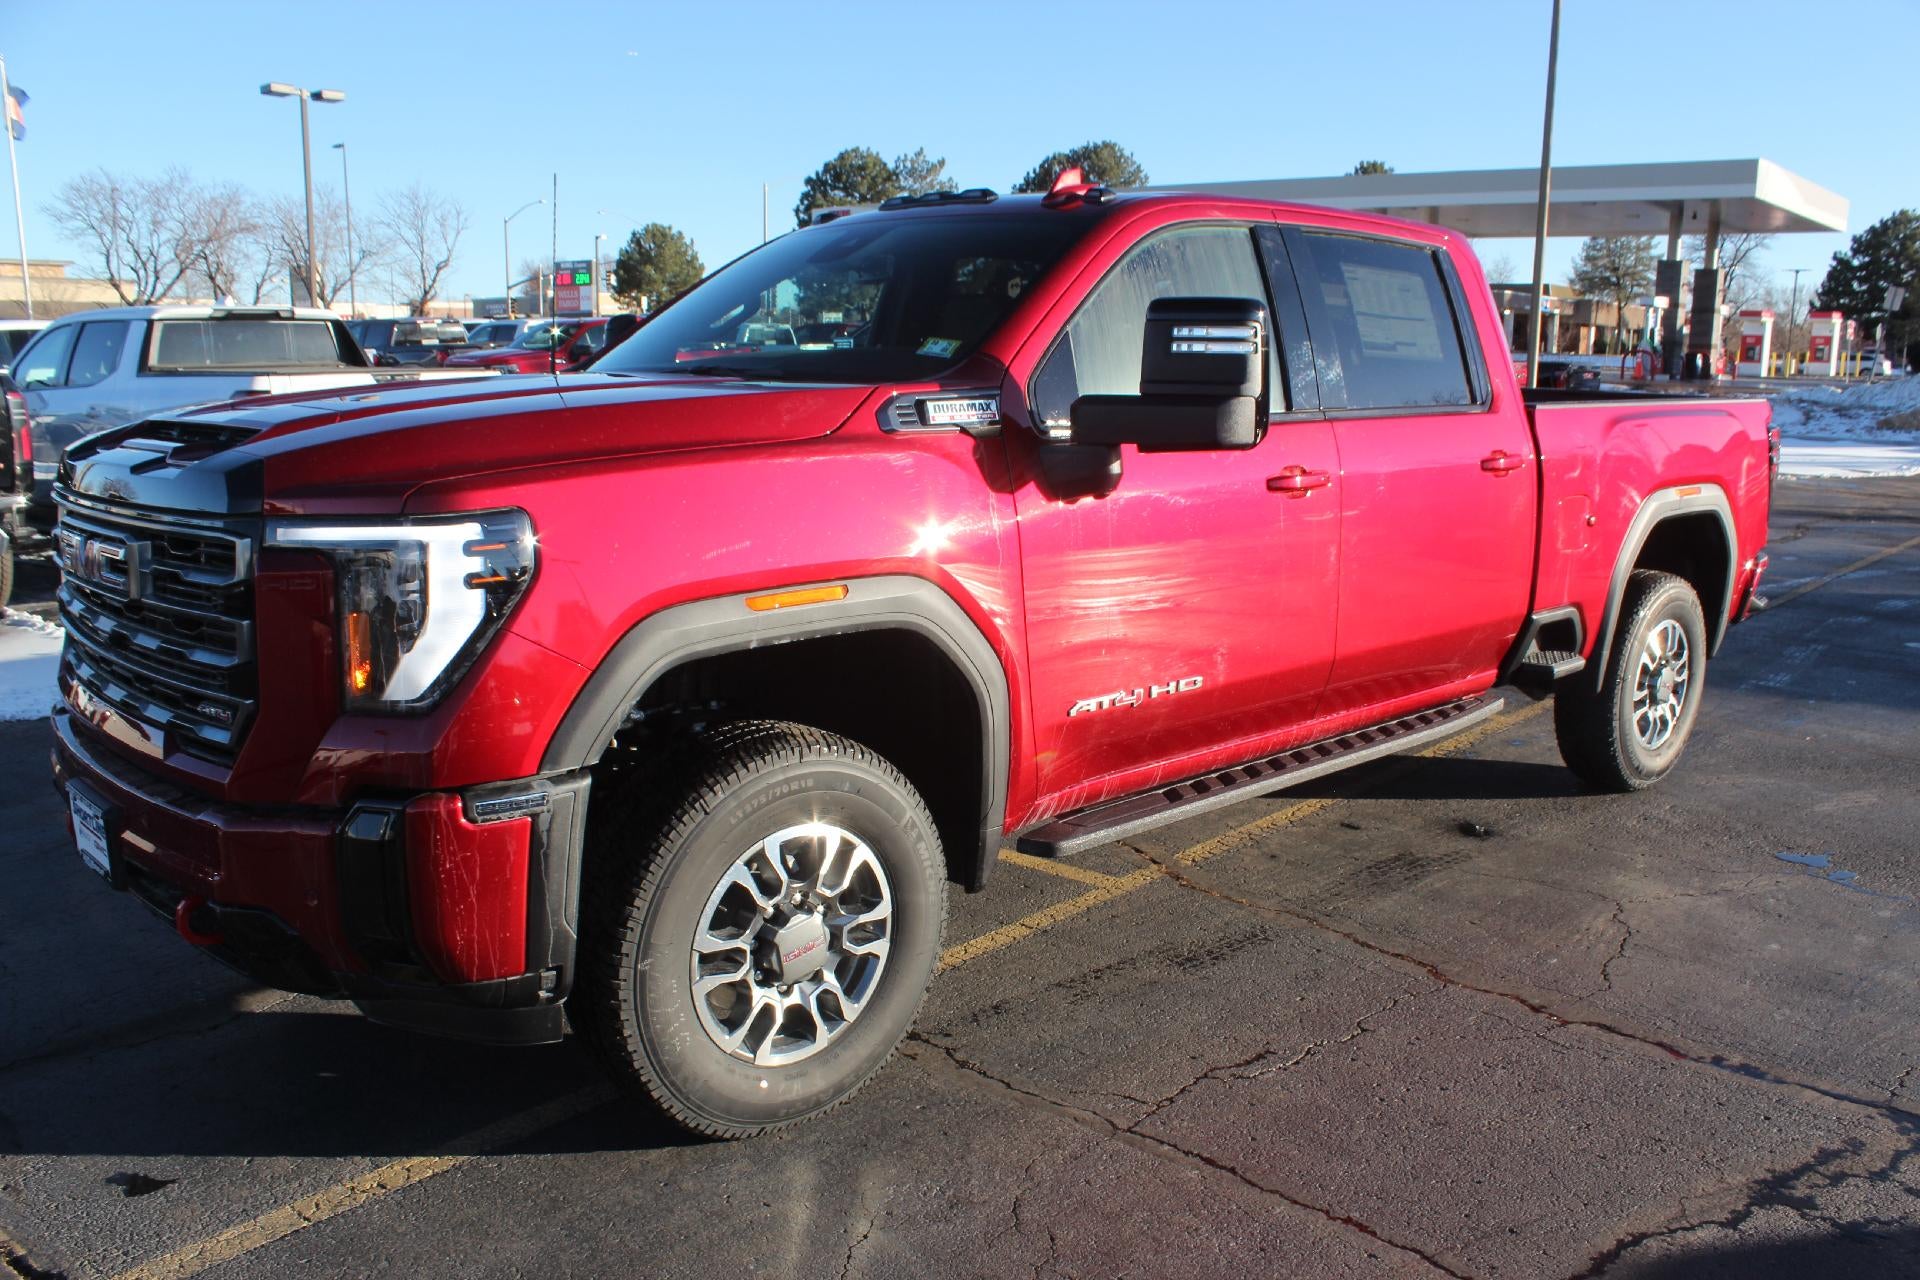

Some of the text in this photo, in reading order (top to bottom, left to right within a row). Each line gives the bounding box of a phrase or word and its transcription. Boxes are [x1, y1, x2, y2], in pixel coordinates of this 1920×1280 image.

[933, 402, 993, 413] DURAMAX
[1068, 676, 1203, 717] AT4 HD
